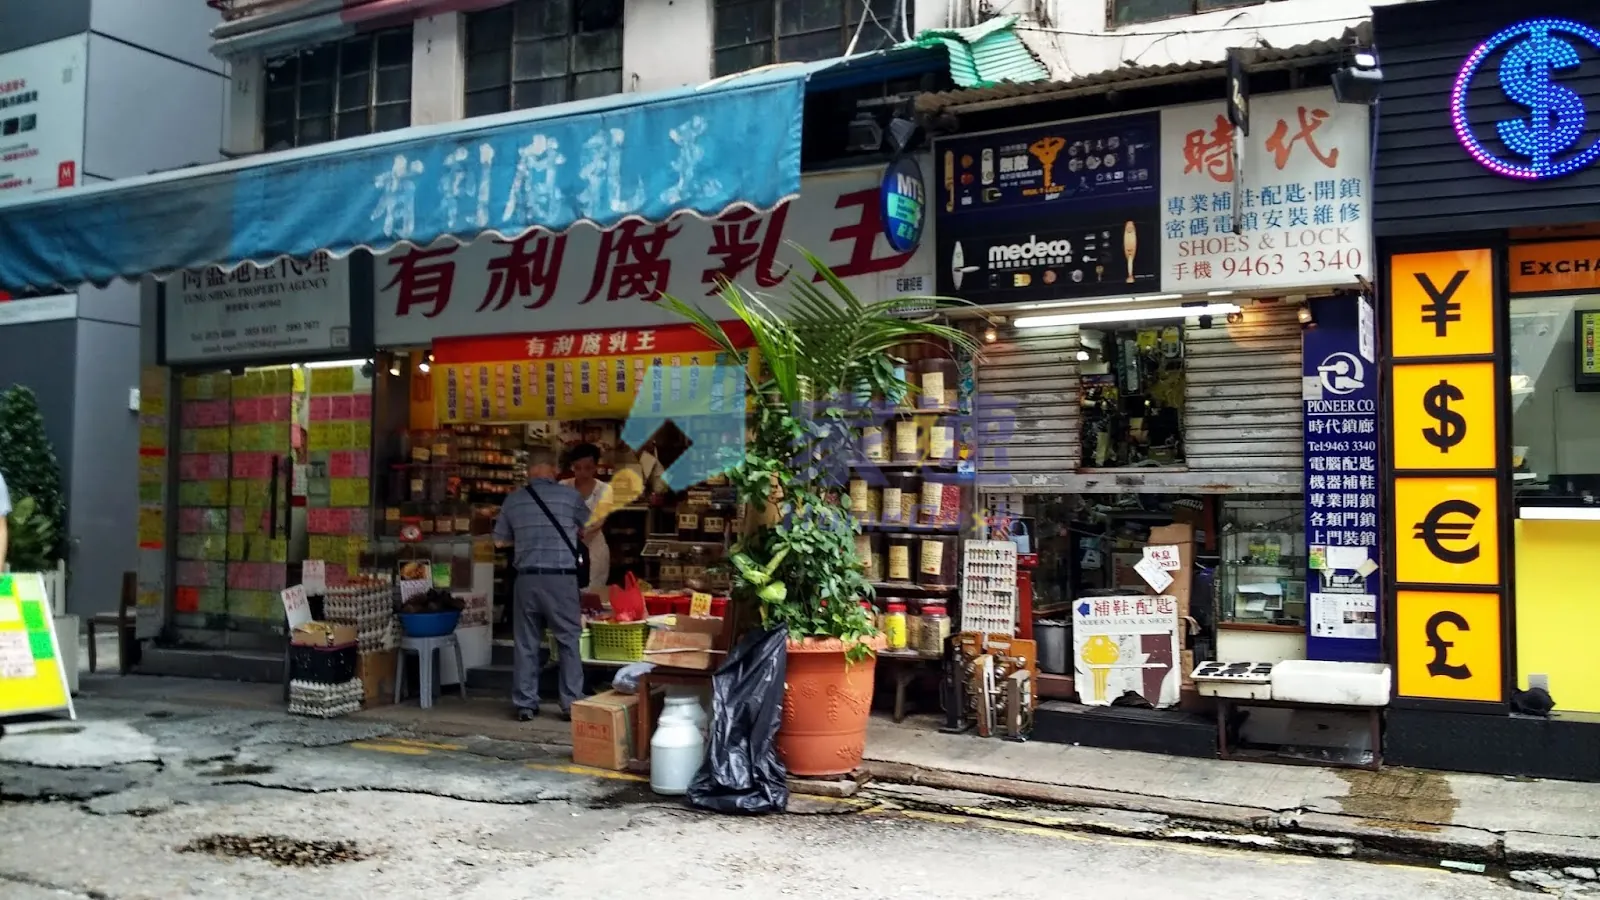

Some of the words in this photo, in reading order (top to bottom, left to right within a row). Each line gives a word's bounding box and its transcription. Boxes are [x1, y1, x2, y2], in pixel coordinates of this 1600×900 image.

[1183, 106, 1339, 183] 時代
[1165, 202, 1361, 240] 密碼電鎖安裝維修
[988, 234, 1072, 262] medeco
[1178, 234, 1250, 258] SHOES
[1258, 232, 1275, 250] &
[1284, 226, 1353, 249] LOCK
[1171, 261, 1213, 281] 手機
[1222, 252, 1285, 279] 9463
[1298, 247, 1362, 274] 3340
[289, 277, 329, 292] AGENCY
[525, 329, 657, 358] 有利腐乳王
[1307, 399, 1356, 413] PIONEER
[1357, 399, 1375, 412] CO.
[1308, 418, 1375, 435] 時代鎖廊
[1351, 440, 1376, 452] 3340
[1308, 456, 1375, 472] 電腦配匙
[1309, 474, 1376, 490] 機器補鞋
[1310, 493, 1376, 509] 專業開鎖
[1309, 511, 1376, 528] 各類門鎖
[1310, 530, 1377, 547] 上門裝鎖
[1094, 597, 1174, 618] 補鞋·配匙
[1148, 617, 1173, 625] SHOES
